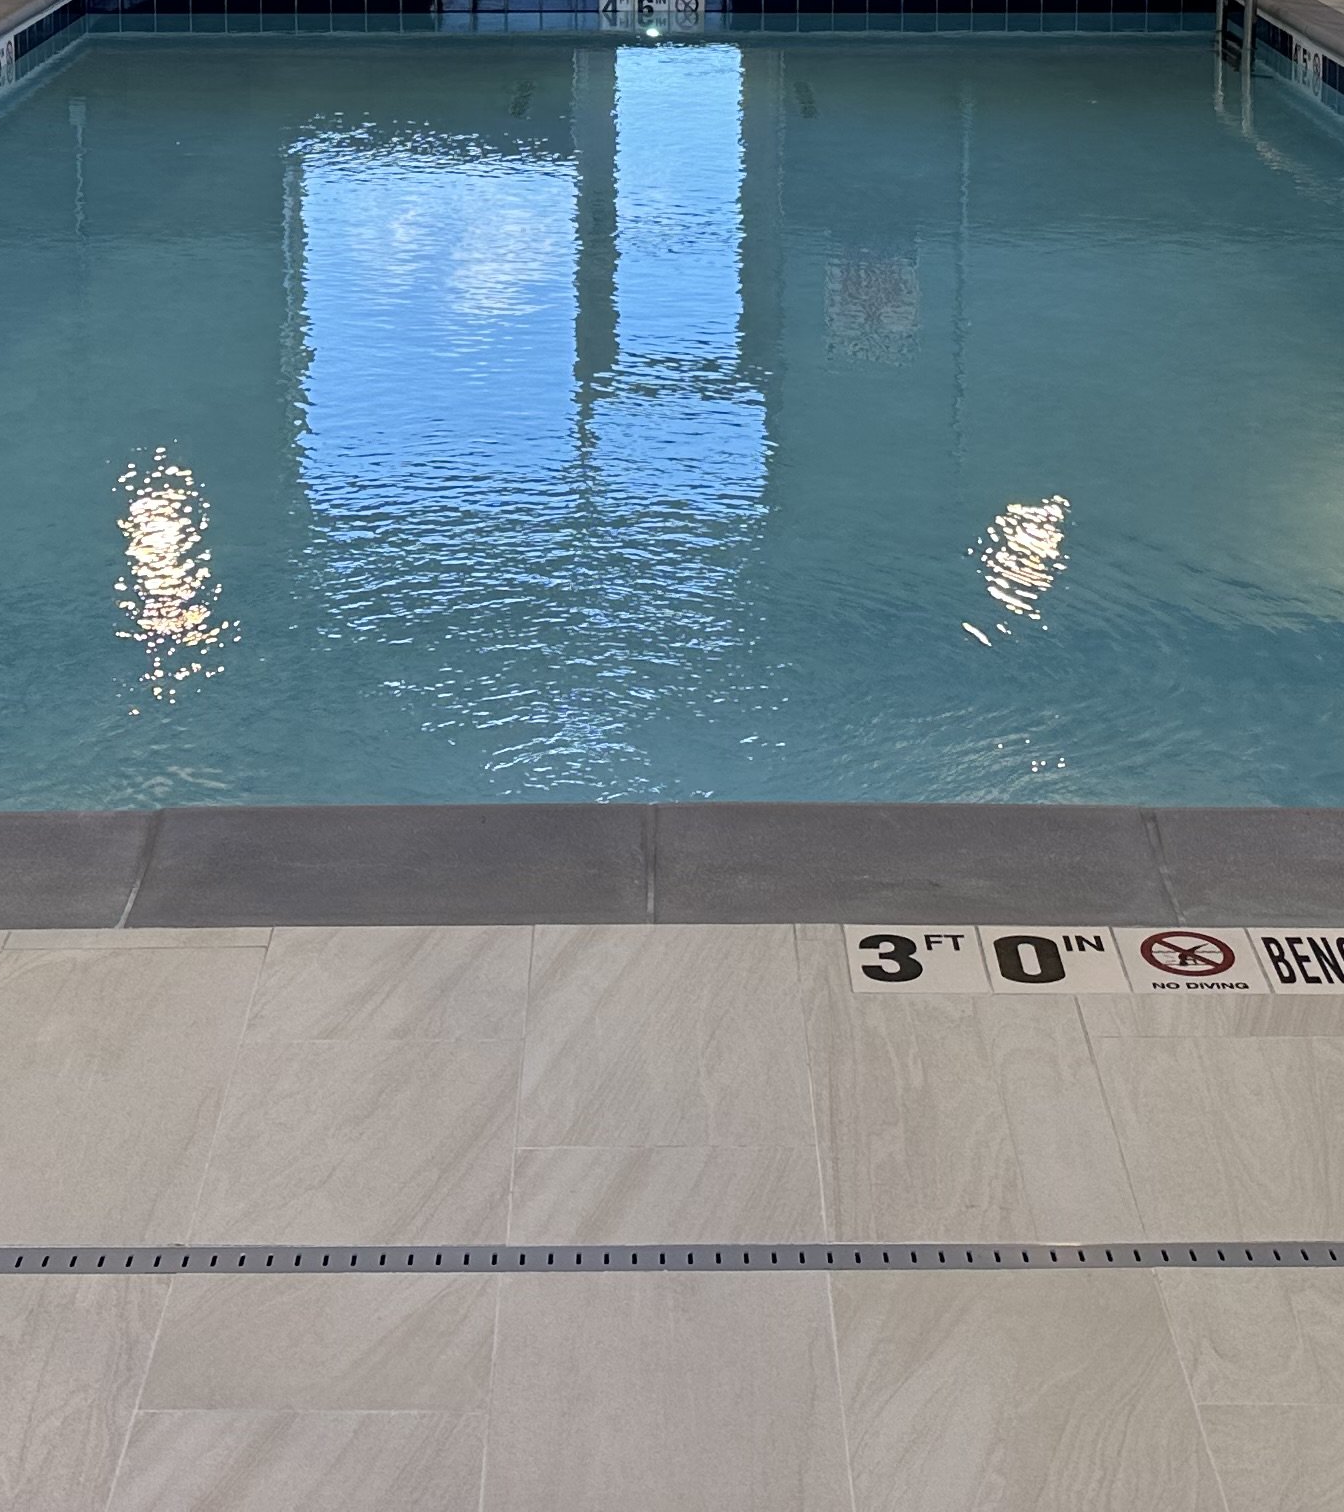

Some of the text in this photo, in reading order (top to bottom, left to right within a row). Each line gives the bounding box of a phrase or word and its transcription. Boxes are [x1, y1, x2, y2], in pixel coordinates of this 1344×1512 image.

[858, 934, 924, 984] 3
[923, 934, 966, 953] FT
[993, 935, 1066, 985] 0
[1064, 934, 1106, 954] IN
[1152, 982, 1250, 990] NO DIVING
